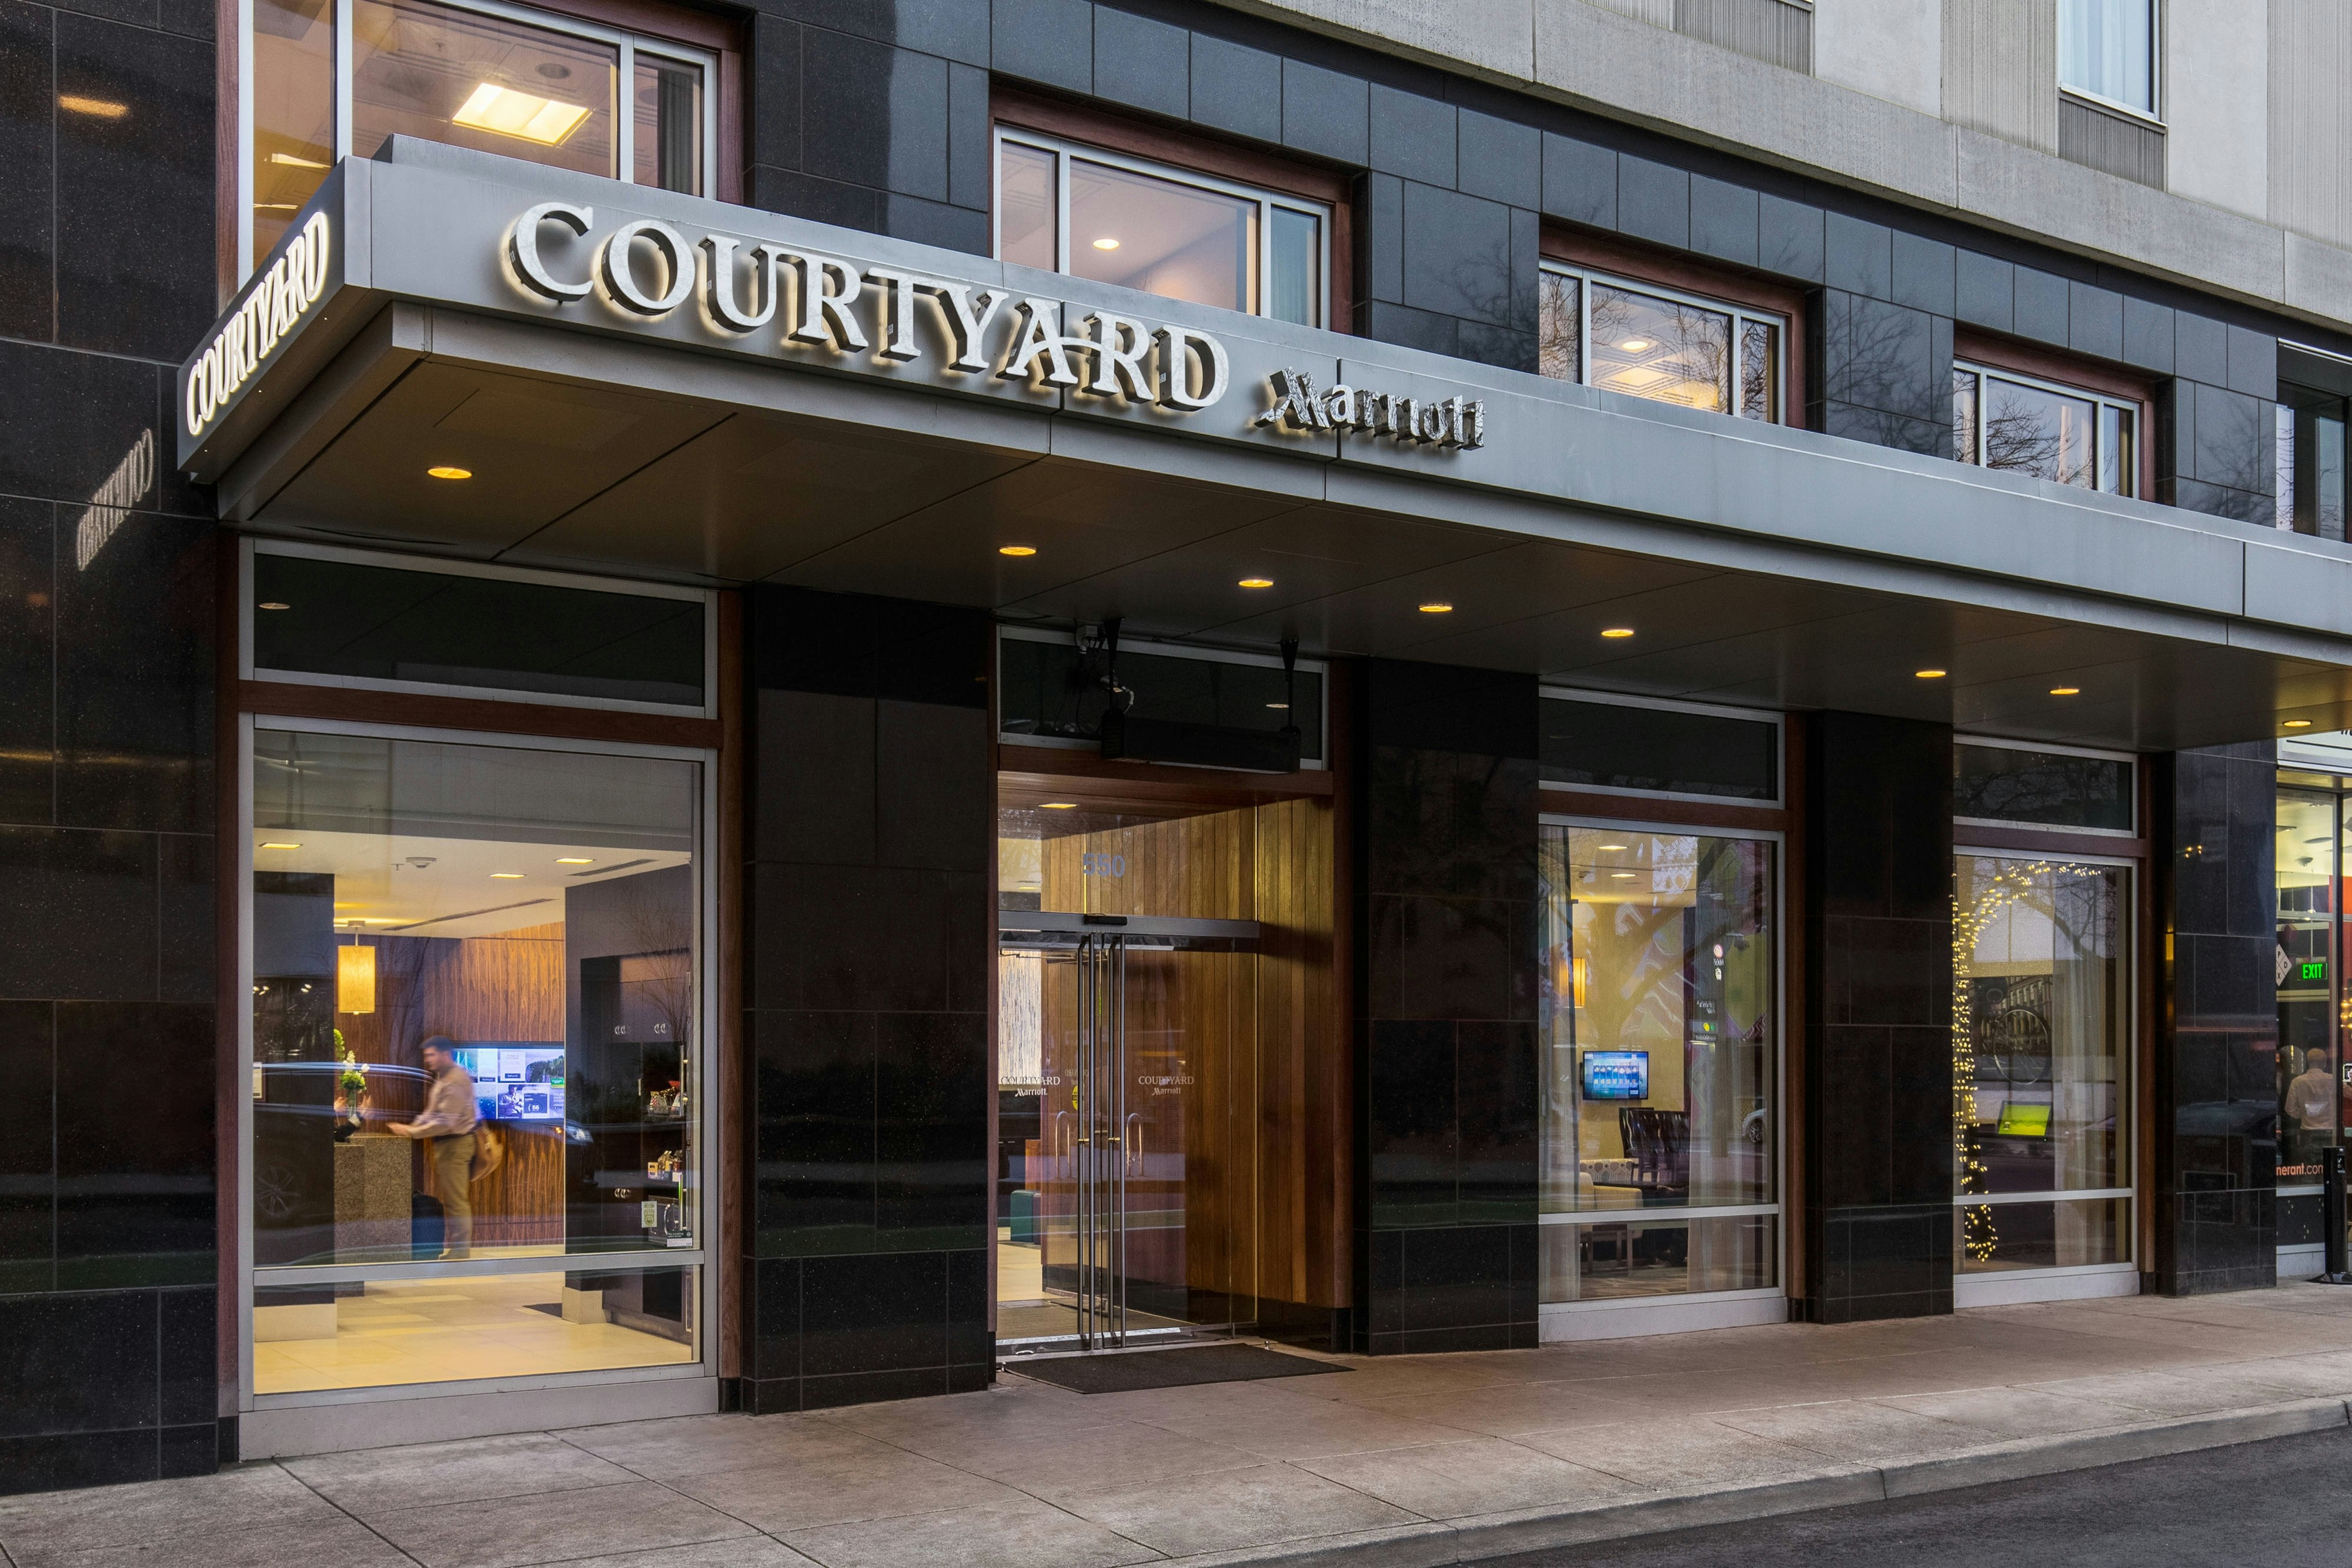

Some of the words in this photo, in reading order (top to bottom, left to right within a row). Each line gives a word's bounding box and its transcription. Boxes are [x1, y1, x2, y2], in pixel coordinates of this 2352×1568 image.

[186, 211, 329, 436] COURTYARD
[510, 202, 1230, 412] COURTYARD
[1255, 367, 1486, 452] Marriott
[1083, 853, 1125, 878] 550
[2303, 964, 2323, 979] EXIT
[1001, 1076, 1061, 1085] COURTYARD
[1015, 1088, 1047, 1098] Marriott
[1152, 1087, 1181, 1096] Marriott
